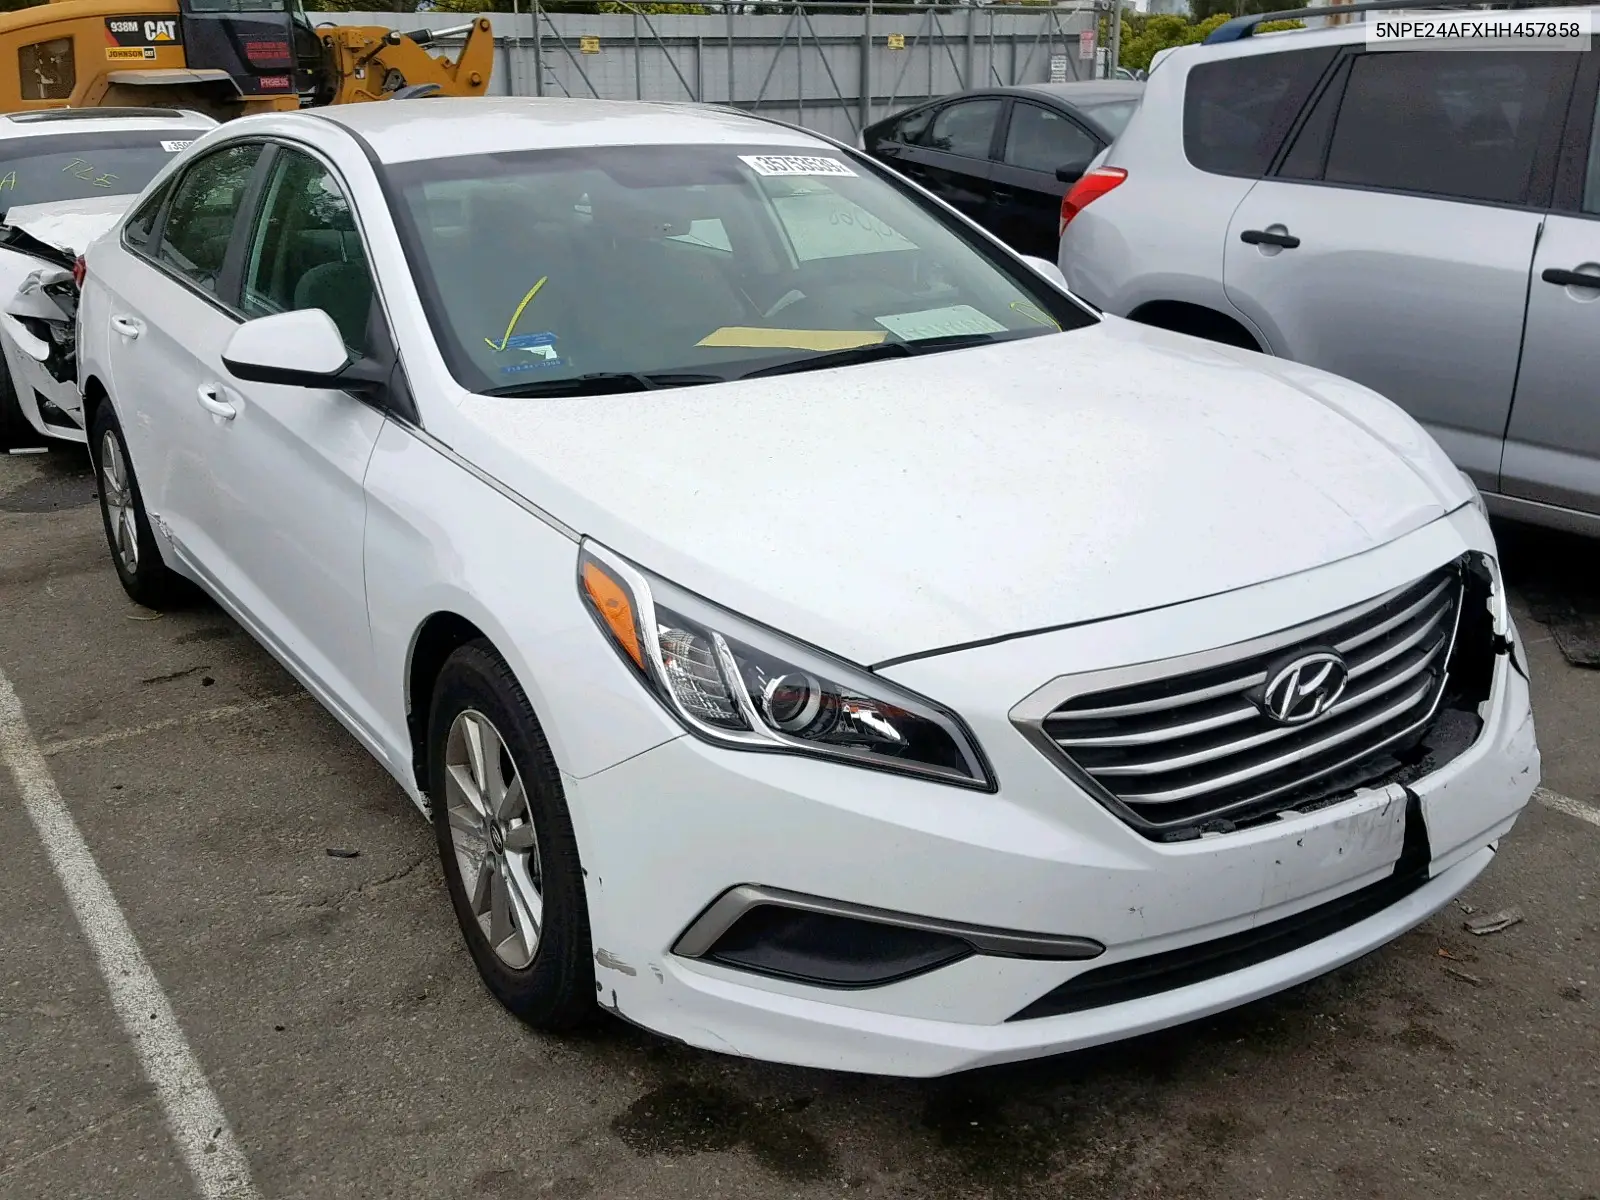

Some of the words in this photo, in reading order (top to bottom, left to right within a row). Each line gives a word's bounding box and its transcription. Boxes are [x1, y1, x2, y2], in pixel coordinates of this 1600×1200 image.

[110, 21, 139, 33] 938M
[144, 20, 176, 41] CAT
[108, 49, 143, 58] JOHNSON
